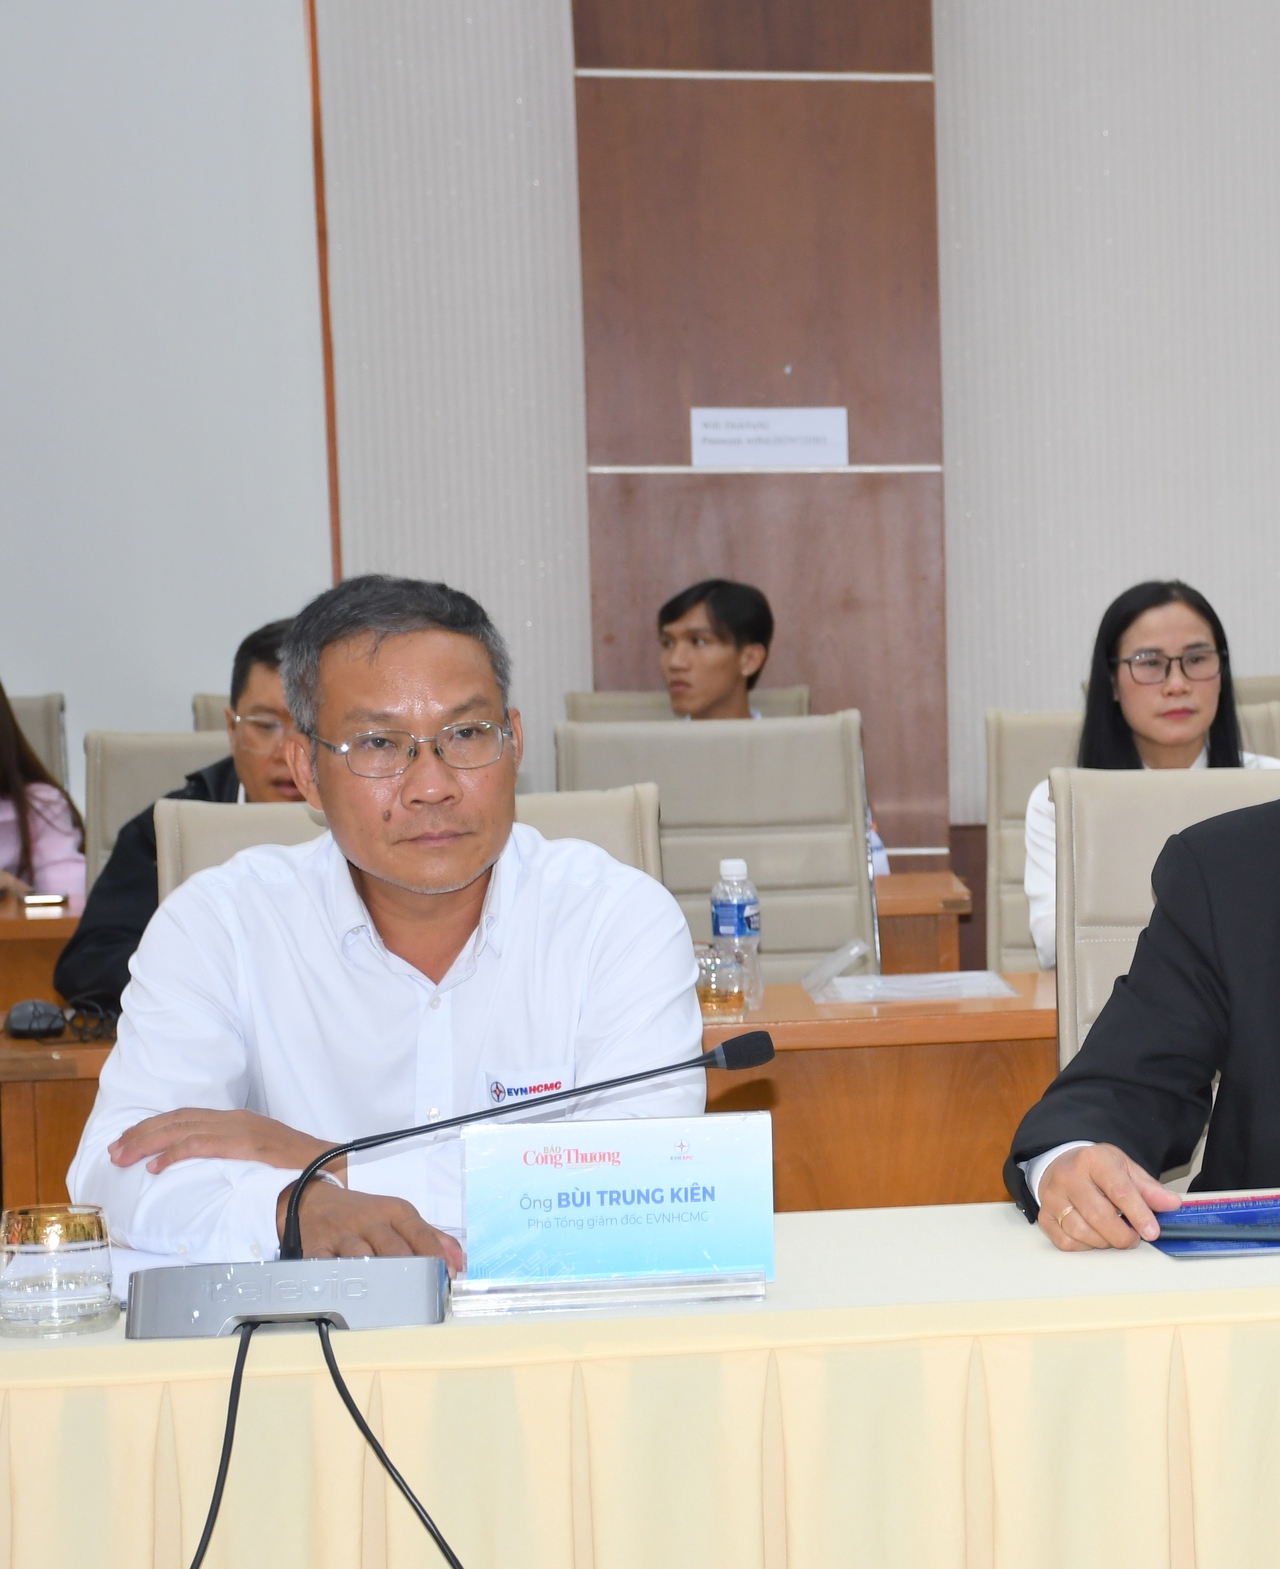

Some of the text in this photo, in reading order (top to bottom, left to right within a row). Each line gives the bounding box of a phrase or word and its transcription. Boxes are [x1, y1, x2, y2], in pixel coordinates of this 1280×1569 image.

[507, 1081, 562, 1097] EVNHCMC
[543, 1145, 562, 1154] BÁO
[522, 1150, 563, 1169] Công
[519, 1182, 716, 1212] Ông BÙI TRUNG KIÊN
[527, 1218, 552, 1229] Phó
[587, 1215, 618, 1229] giám
[620, 1213, 643, 1225] đốc
[646, 1211, 710, 1225] EVNHCMC
[202, 1270, 368, 1303] televic
